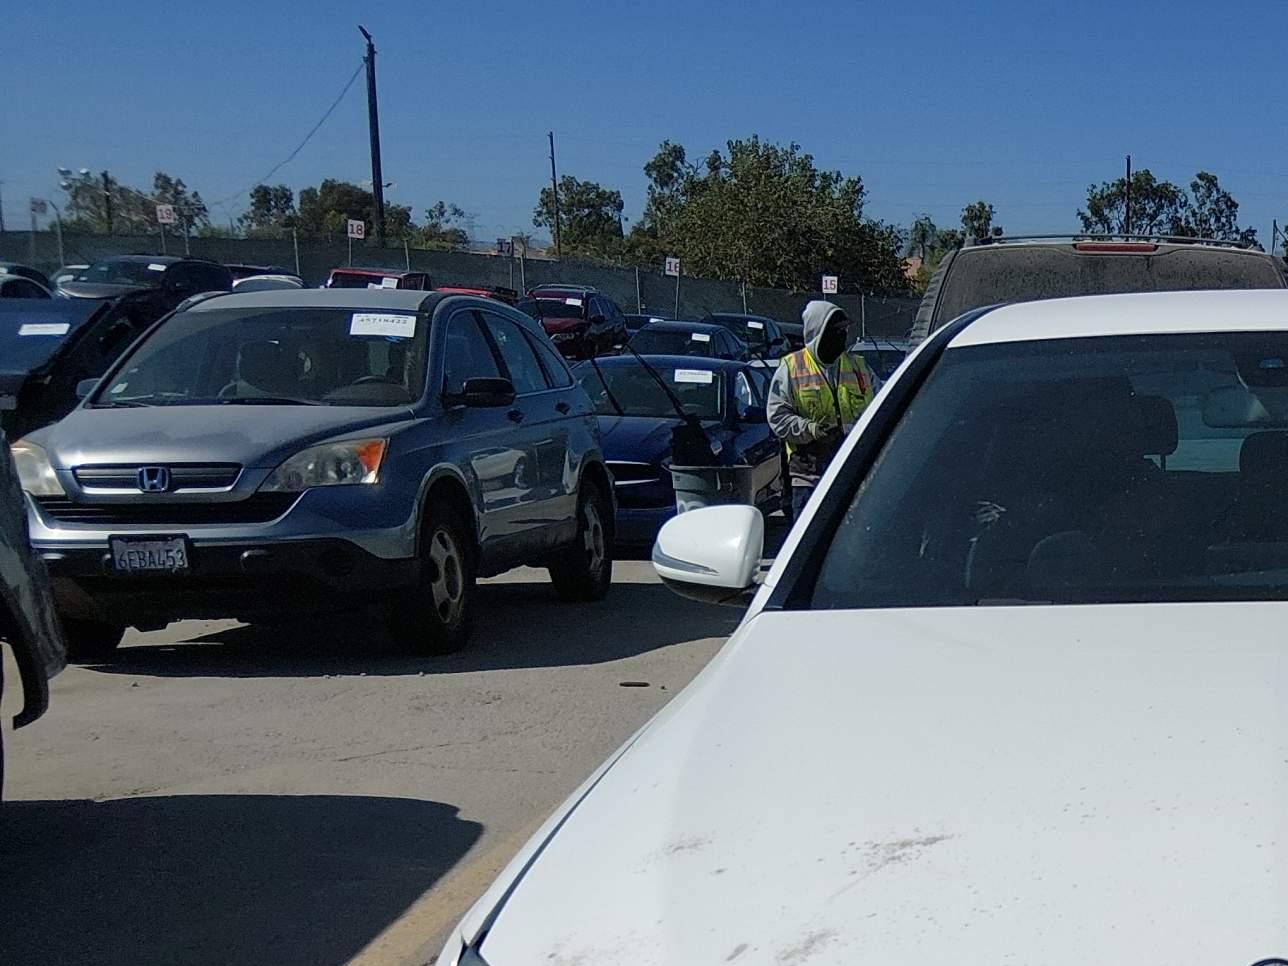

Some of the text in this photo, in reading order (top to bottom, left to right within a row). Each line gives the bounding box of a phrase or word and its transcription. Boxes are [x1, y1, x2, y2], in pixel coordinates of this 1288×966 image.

[159, 208, 172, 220] 19
[349, 223, 364, 236] 18
[823, 279, 837, 290] 15
[118, 549, 185, 569] 6EBA453
